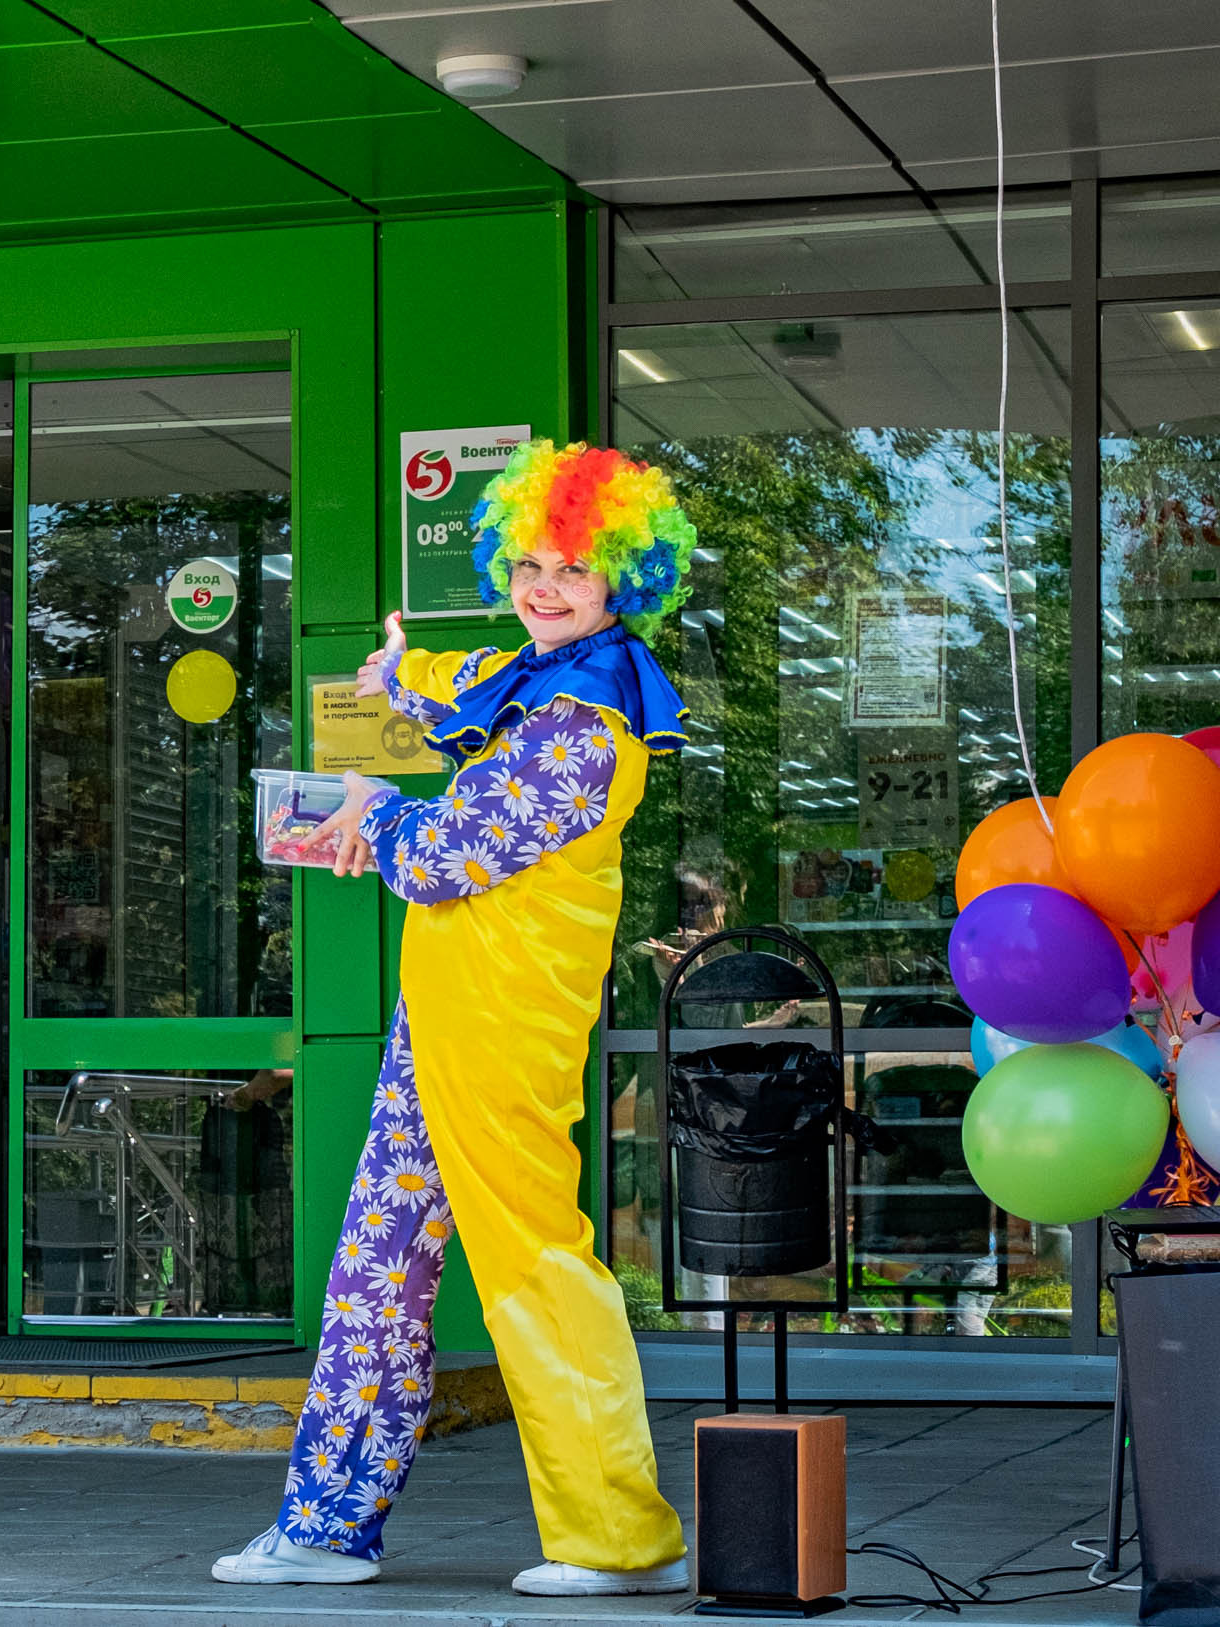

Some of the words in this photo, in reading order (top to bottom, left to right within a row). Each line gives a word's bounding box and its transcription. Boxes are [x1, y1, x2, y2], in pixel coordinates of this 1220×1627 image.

[461, 446, 519, 458] Военто
[184, 573, 221, 586] Вход
[868, 771, 948, 801] 9-21
